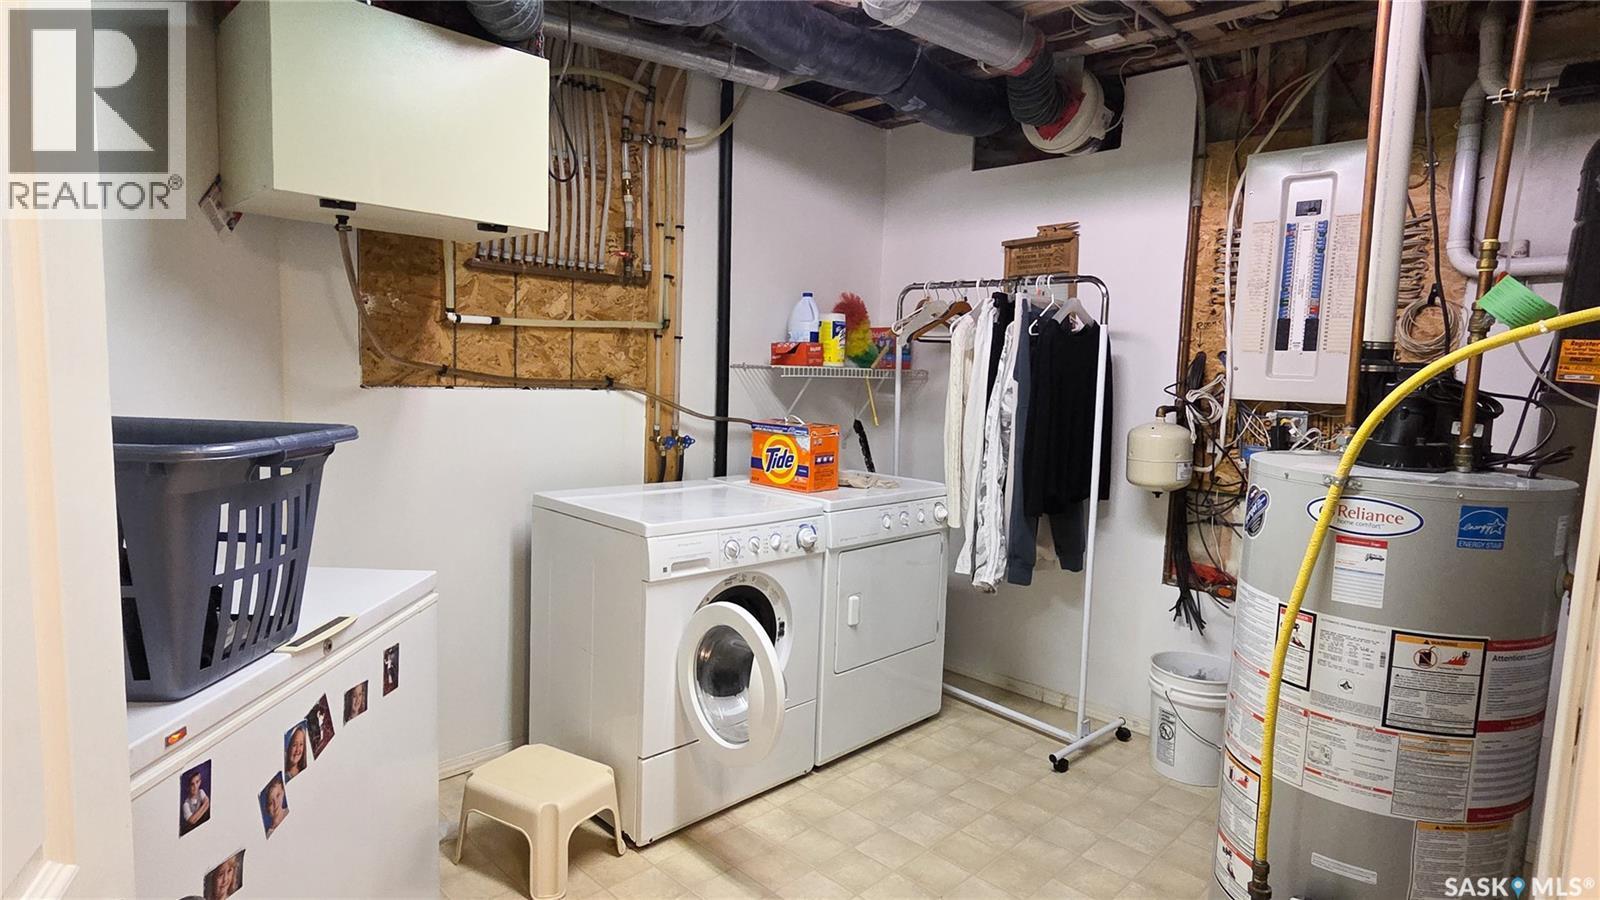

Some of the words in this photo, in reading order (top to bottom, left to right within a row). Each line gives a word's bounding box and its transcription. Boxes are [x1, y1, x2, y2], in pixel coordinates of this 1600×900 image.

[766, 447, 795, 472] Tide
[1337, 504, 1404, 525] Reliance
[1337, 518, 1354, 526] home
[1458, 540, 1485, 548] ENERGY
